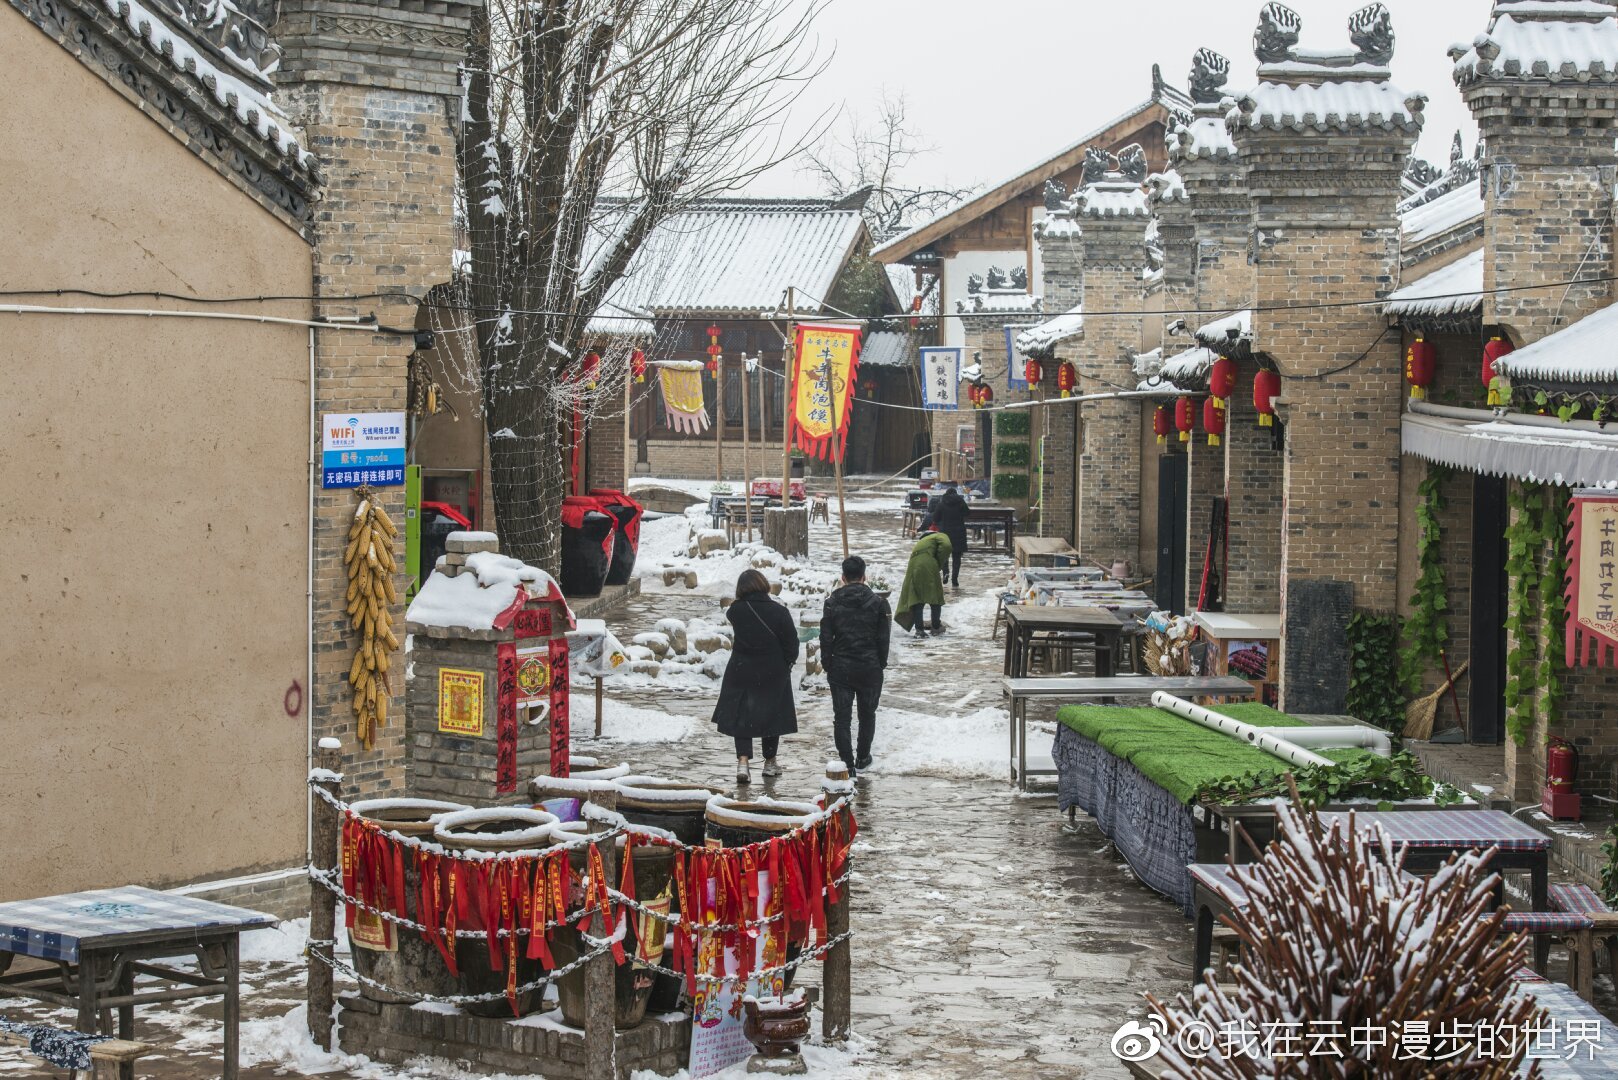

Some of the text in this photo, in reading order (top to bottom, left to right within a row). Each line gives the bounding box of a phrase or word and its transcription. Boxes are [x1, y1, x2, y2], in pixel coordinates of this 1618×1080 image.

[327, 469, 402, 484] 无密码直接连接即可
